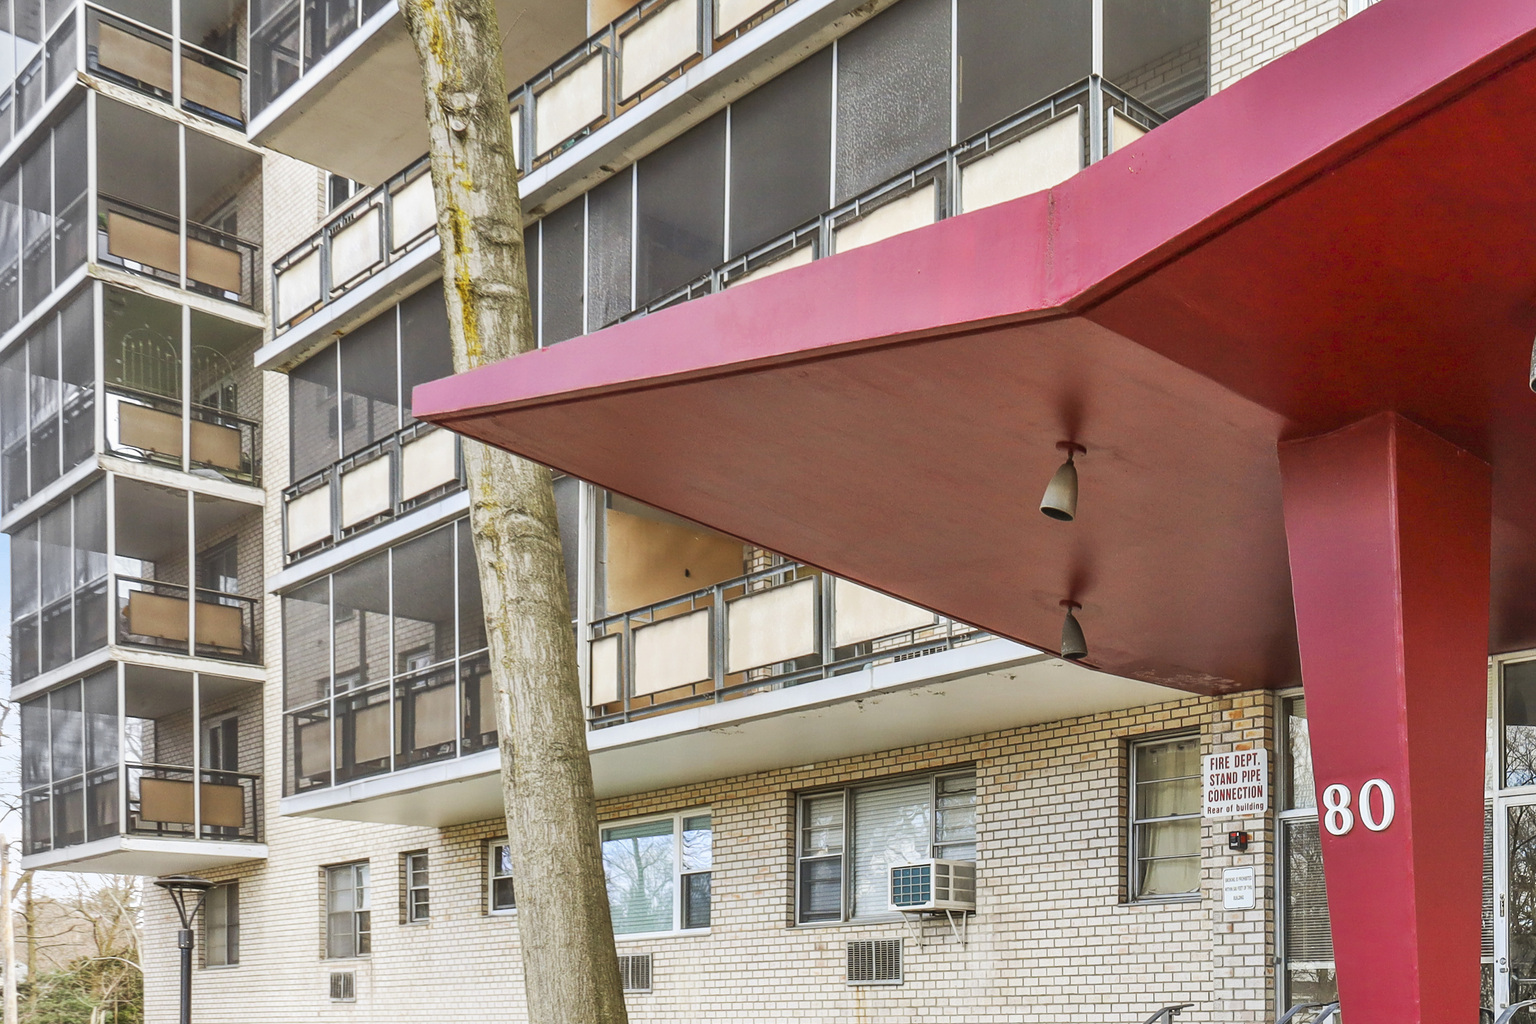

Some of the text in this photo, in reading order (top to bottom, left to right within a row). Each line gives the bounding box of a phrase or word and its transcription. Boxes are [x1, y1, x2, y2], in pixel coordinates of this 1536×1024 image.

[1210, 752, 1261, 770] FIRE DEPT.
[1209, 769, 1261, 786] STAND PIPE
[1208, 785, 1263, 802] CONNECTION
[1207, 802, 1264, 814] Rear of building
[1322, 778, 1395, 836] 80
